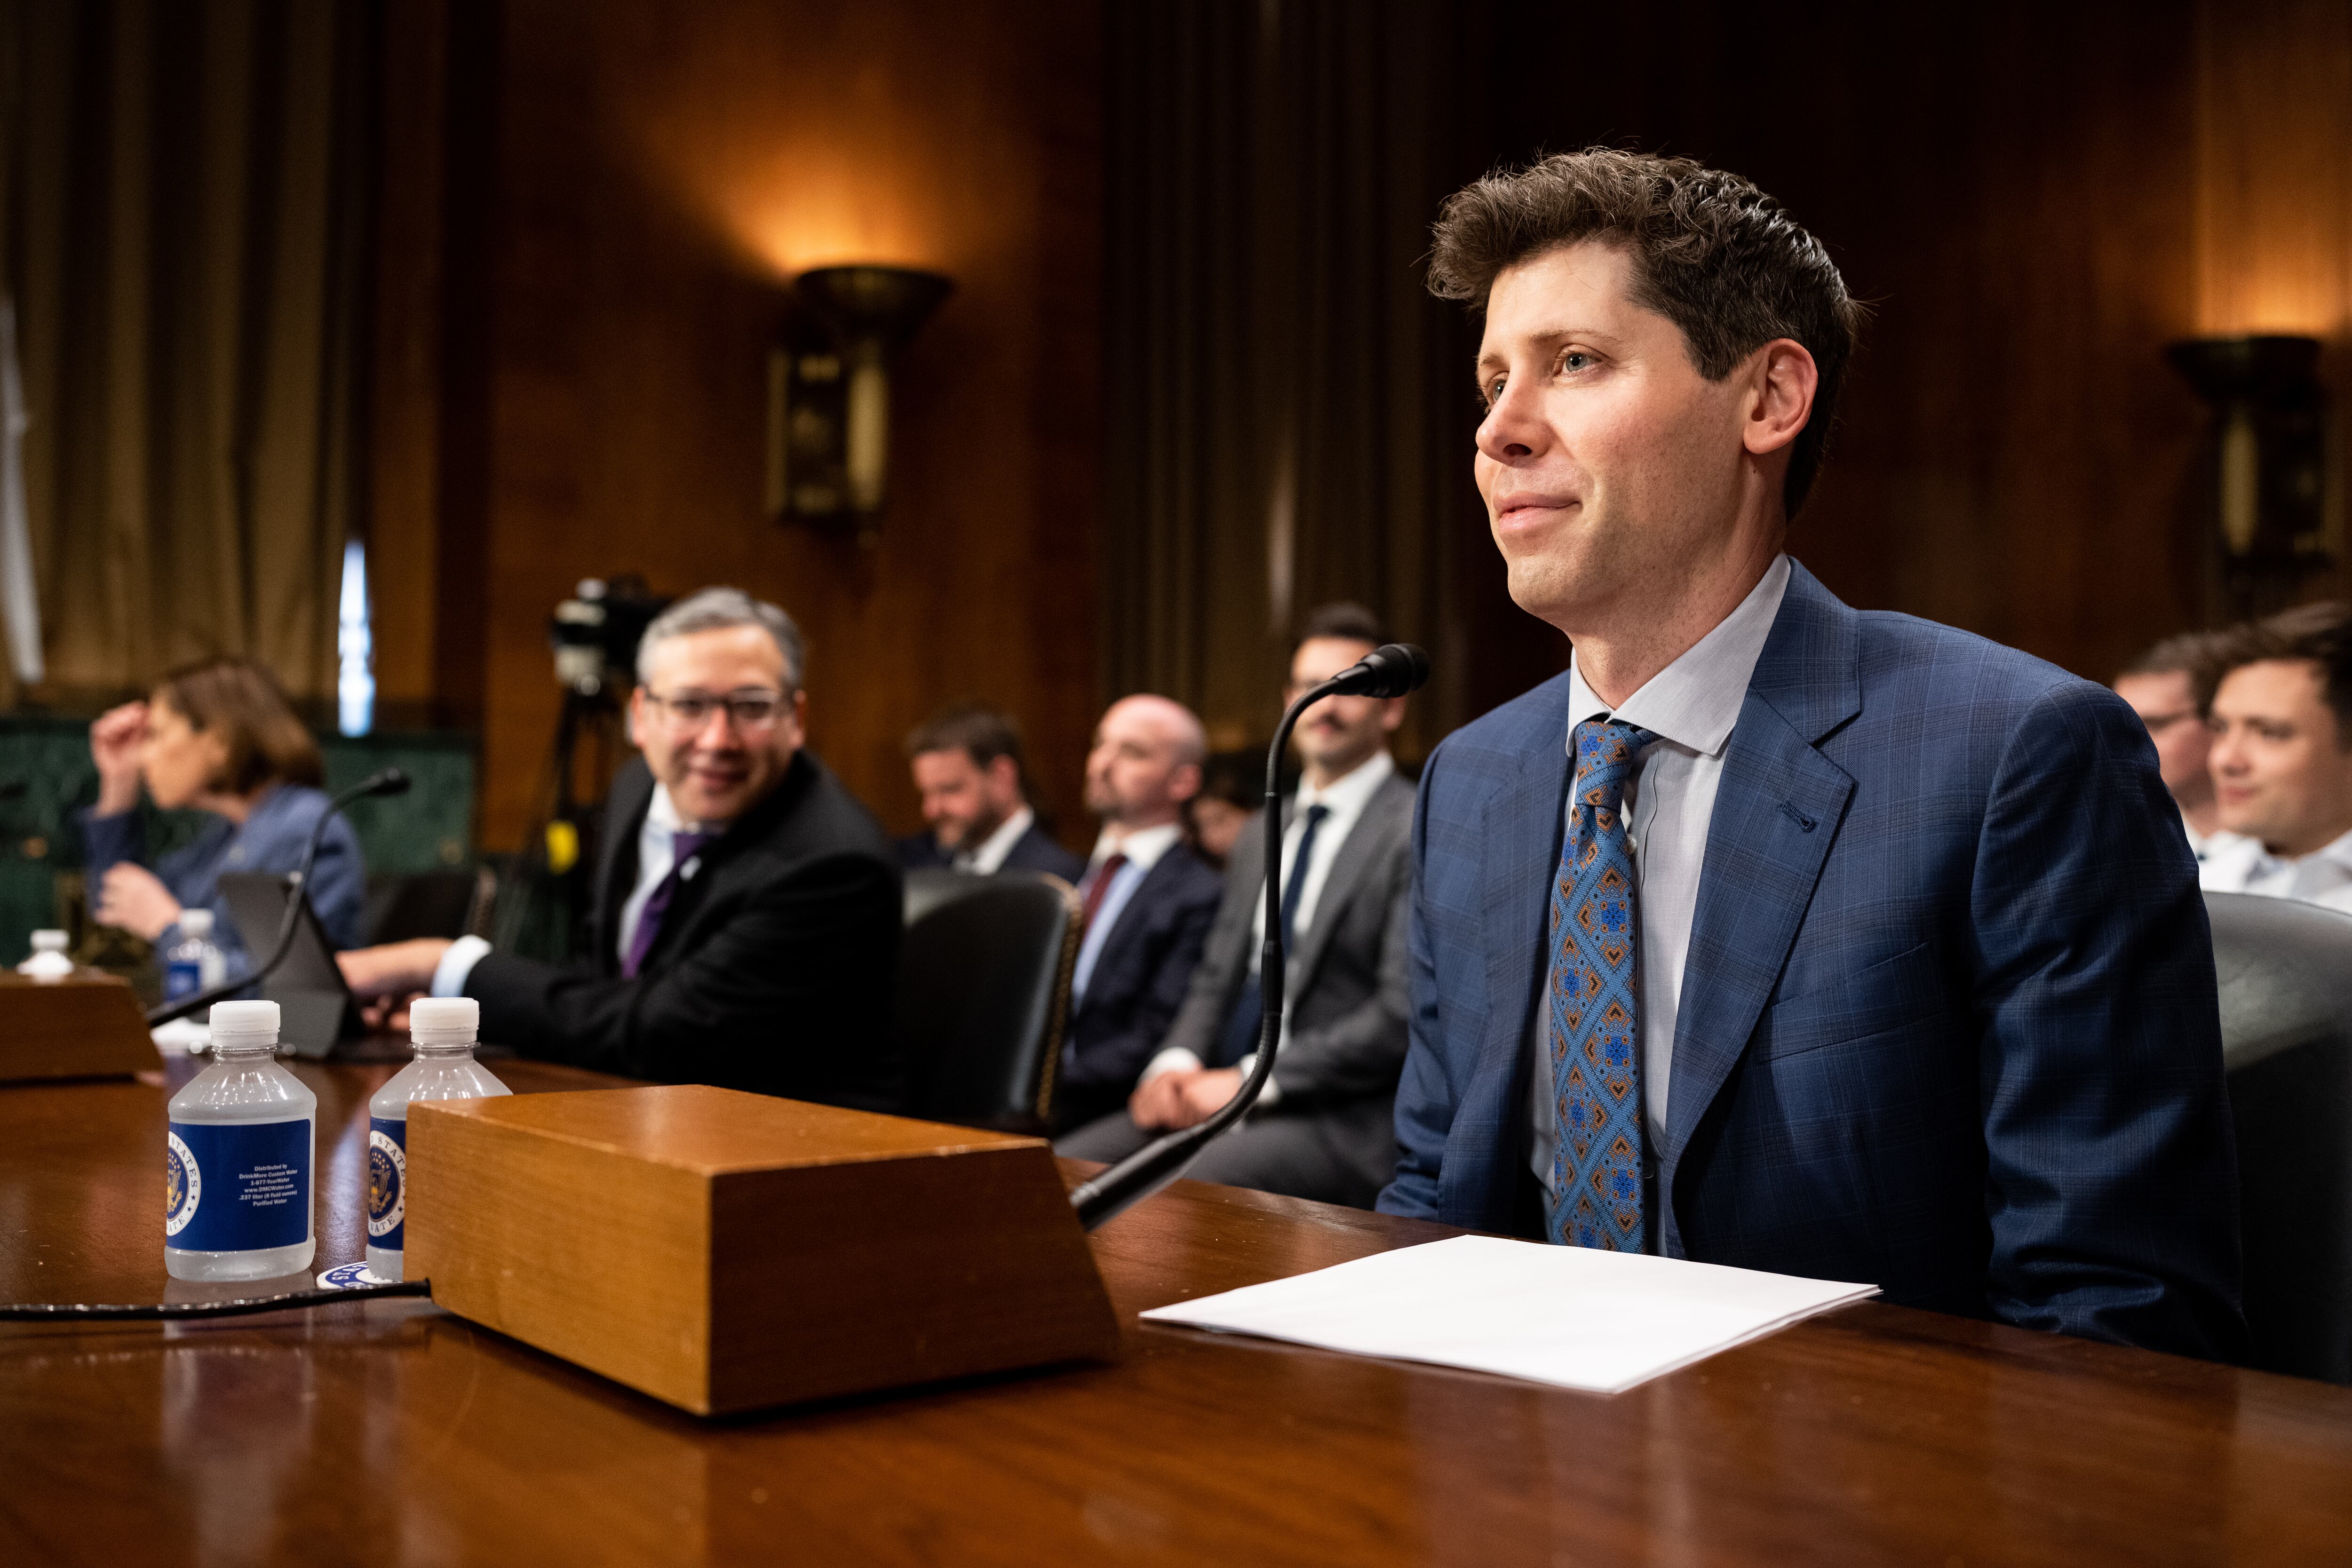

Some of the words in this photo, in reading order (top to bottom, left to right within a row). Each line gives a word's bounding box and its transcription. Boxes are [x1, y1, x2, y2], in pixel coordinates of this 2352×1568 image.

[171, 1138, 198, 1187] STATES
[244, 1184, 294, 1193] www.DMCWater.com
[168, 1215, 185, 1231] ATE
